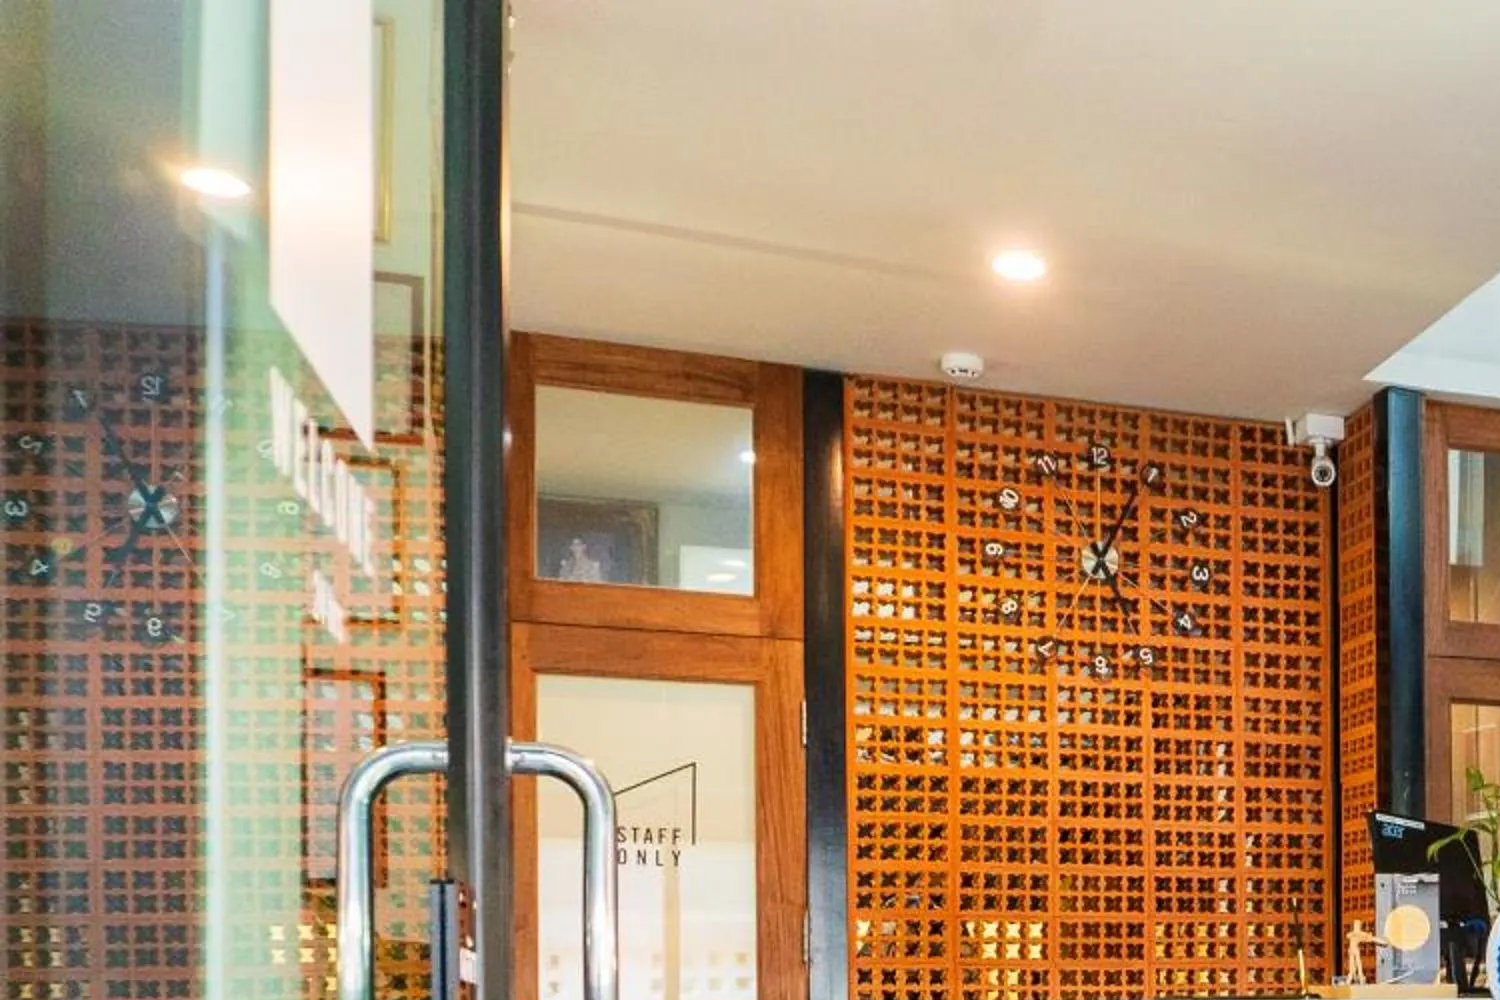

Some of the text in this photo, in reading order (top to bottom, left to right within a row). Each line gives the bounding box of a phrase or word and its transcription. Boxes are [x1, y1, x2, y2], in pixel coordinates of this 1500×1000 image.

[1037, 455, 1058, 475] 11
[1091, 447, 1109, 466] 12
[999, 488, 1020, 510] 10
[1180, 511, 1198, 527] 2
[1192, 566, 1210, 581] 3
[1001, 600, 1018, 615] 8
[1176, 614, 1193, 630] 4
[616, 825, 682, 845] STAFF
[617, 848, 682, 867] ONLY
